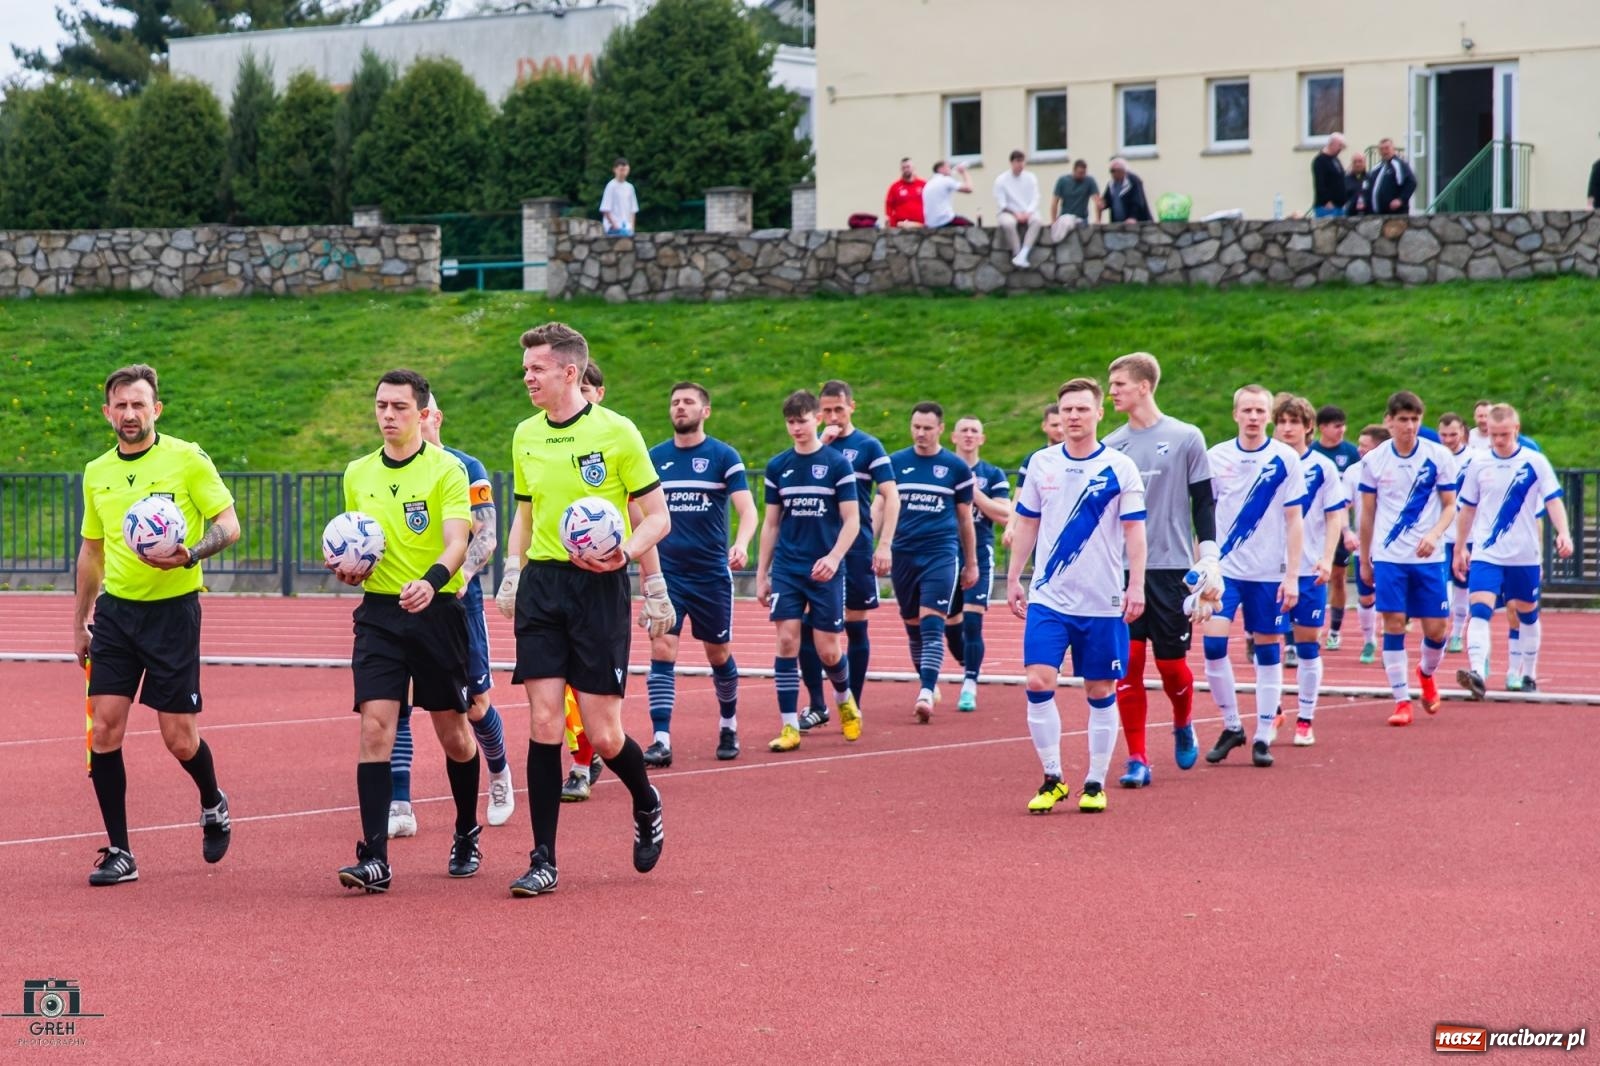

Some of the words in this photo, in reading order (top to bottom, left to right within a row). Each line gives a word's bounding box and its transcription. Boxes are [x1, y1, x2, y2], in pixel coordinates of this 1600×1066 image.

[545, 436, 575, 444] macron
[671, 492, 701, 502] SPORT
[910, 493, 938, 502] SPORT
[792, 497, 818, 507] SPORT
